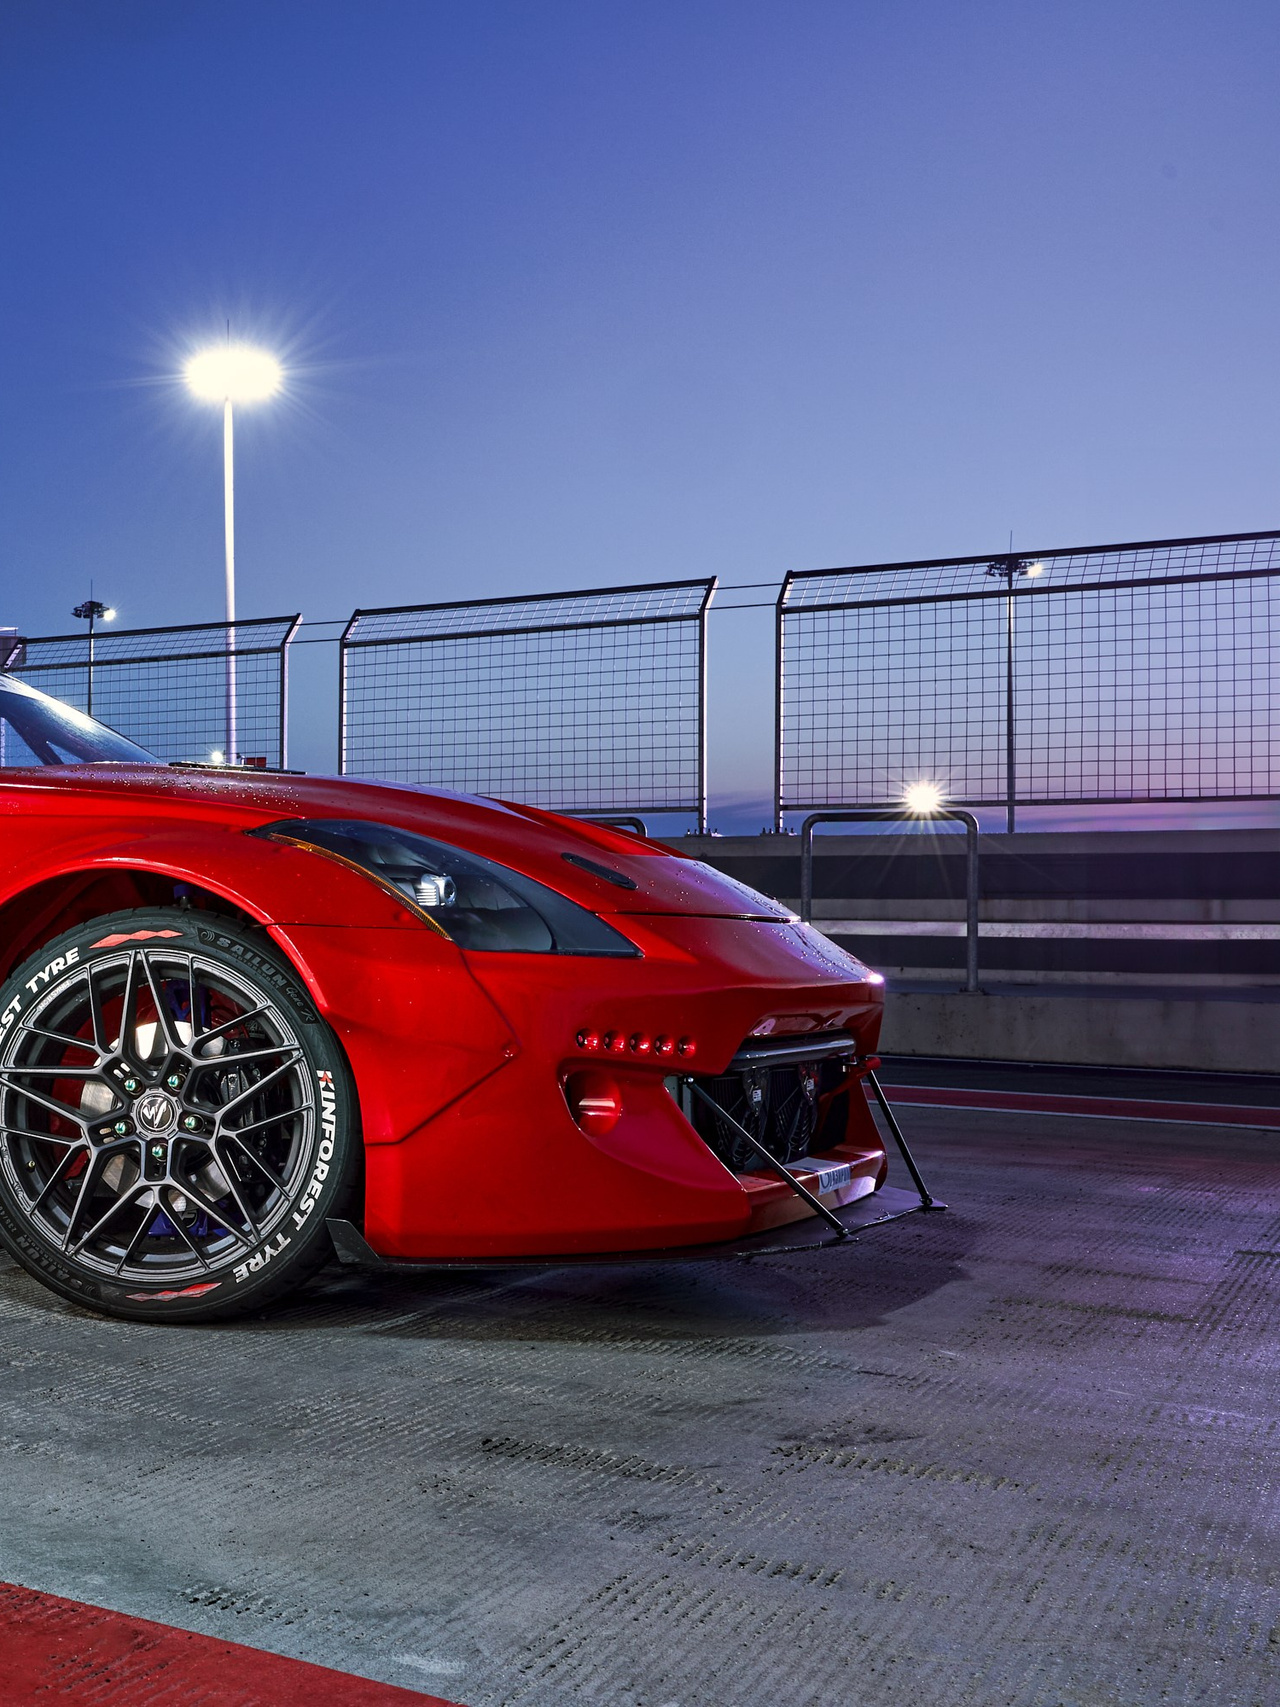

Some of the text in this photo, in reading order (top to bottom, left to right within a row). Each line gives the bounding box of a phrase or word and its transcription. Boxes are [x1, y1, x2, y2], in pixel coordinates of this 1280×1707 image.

[25, 947, 80, 994] TYRE
[216, 937, 287, 987] SAILUN
[233, 1069, 336, 1284] KINFOREST TYRE
[16, 1235, 83, 1289] SAILUN
